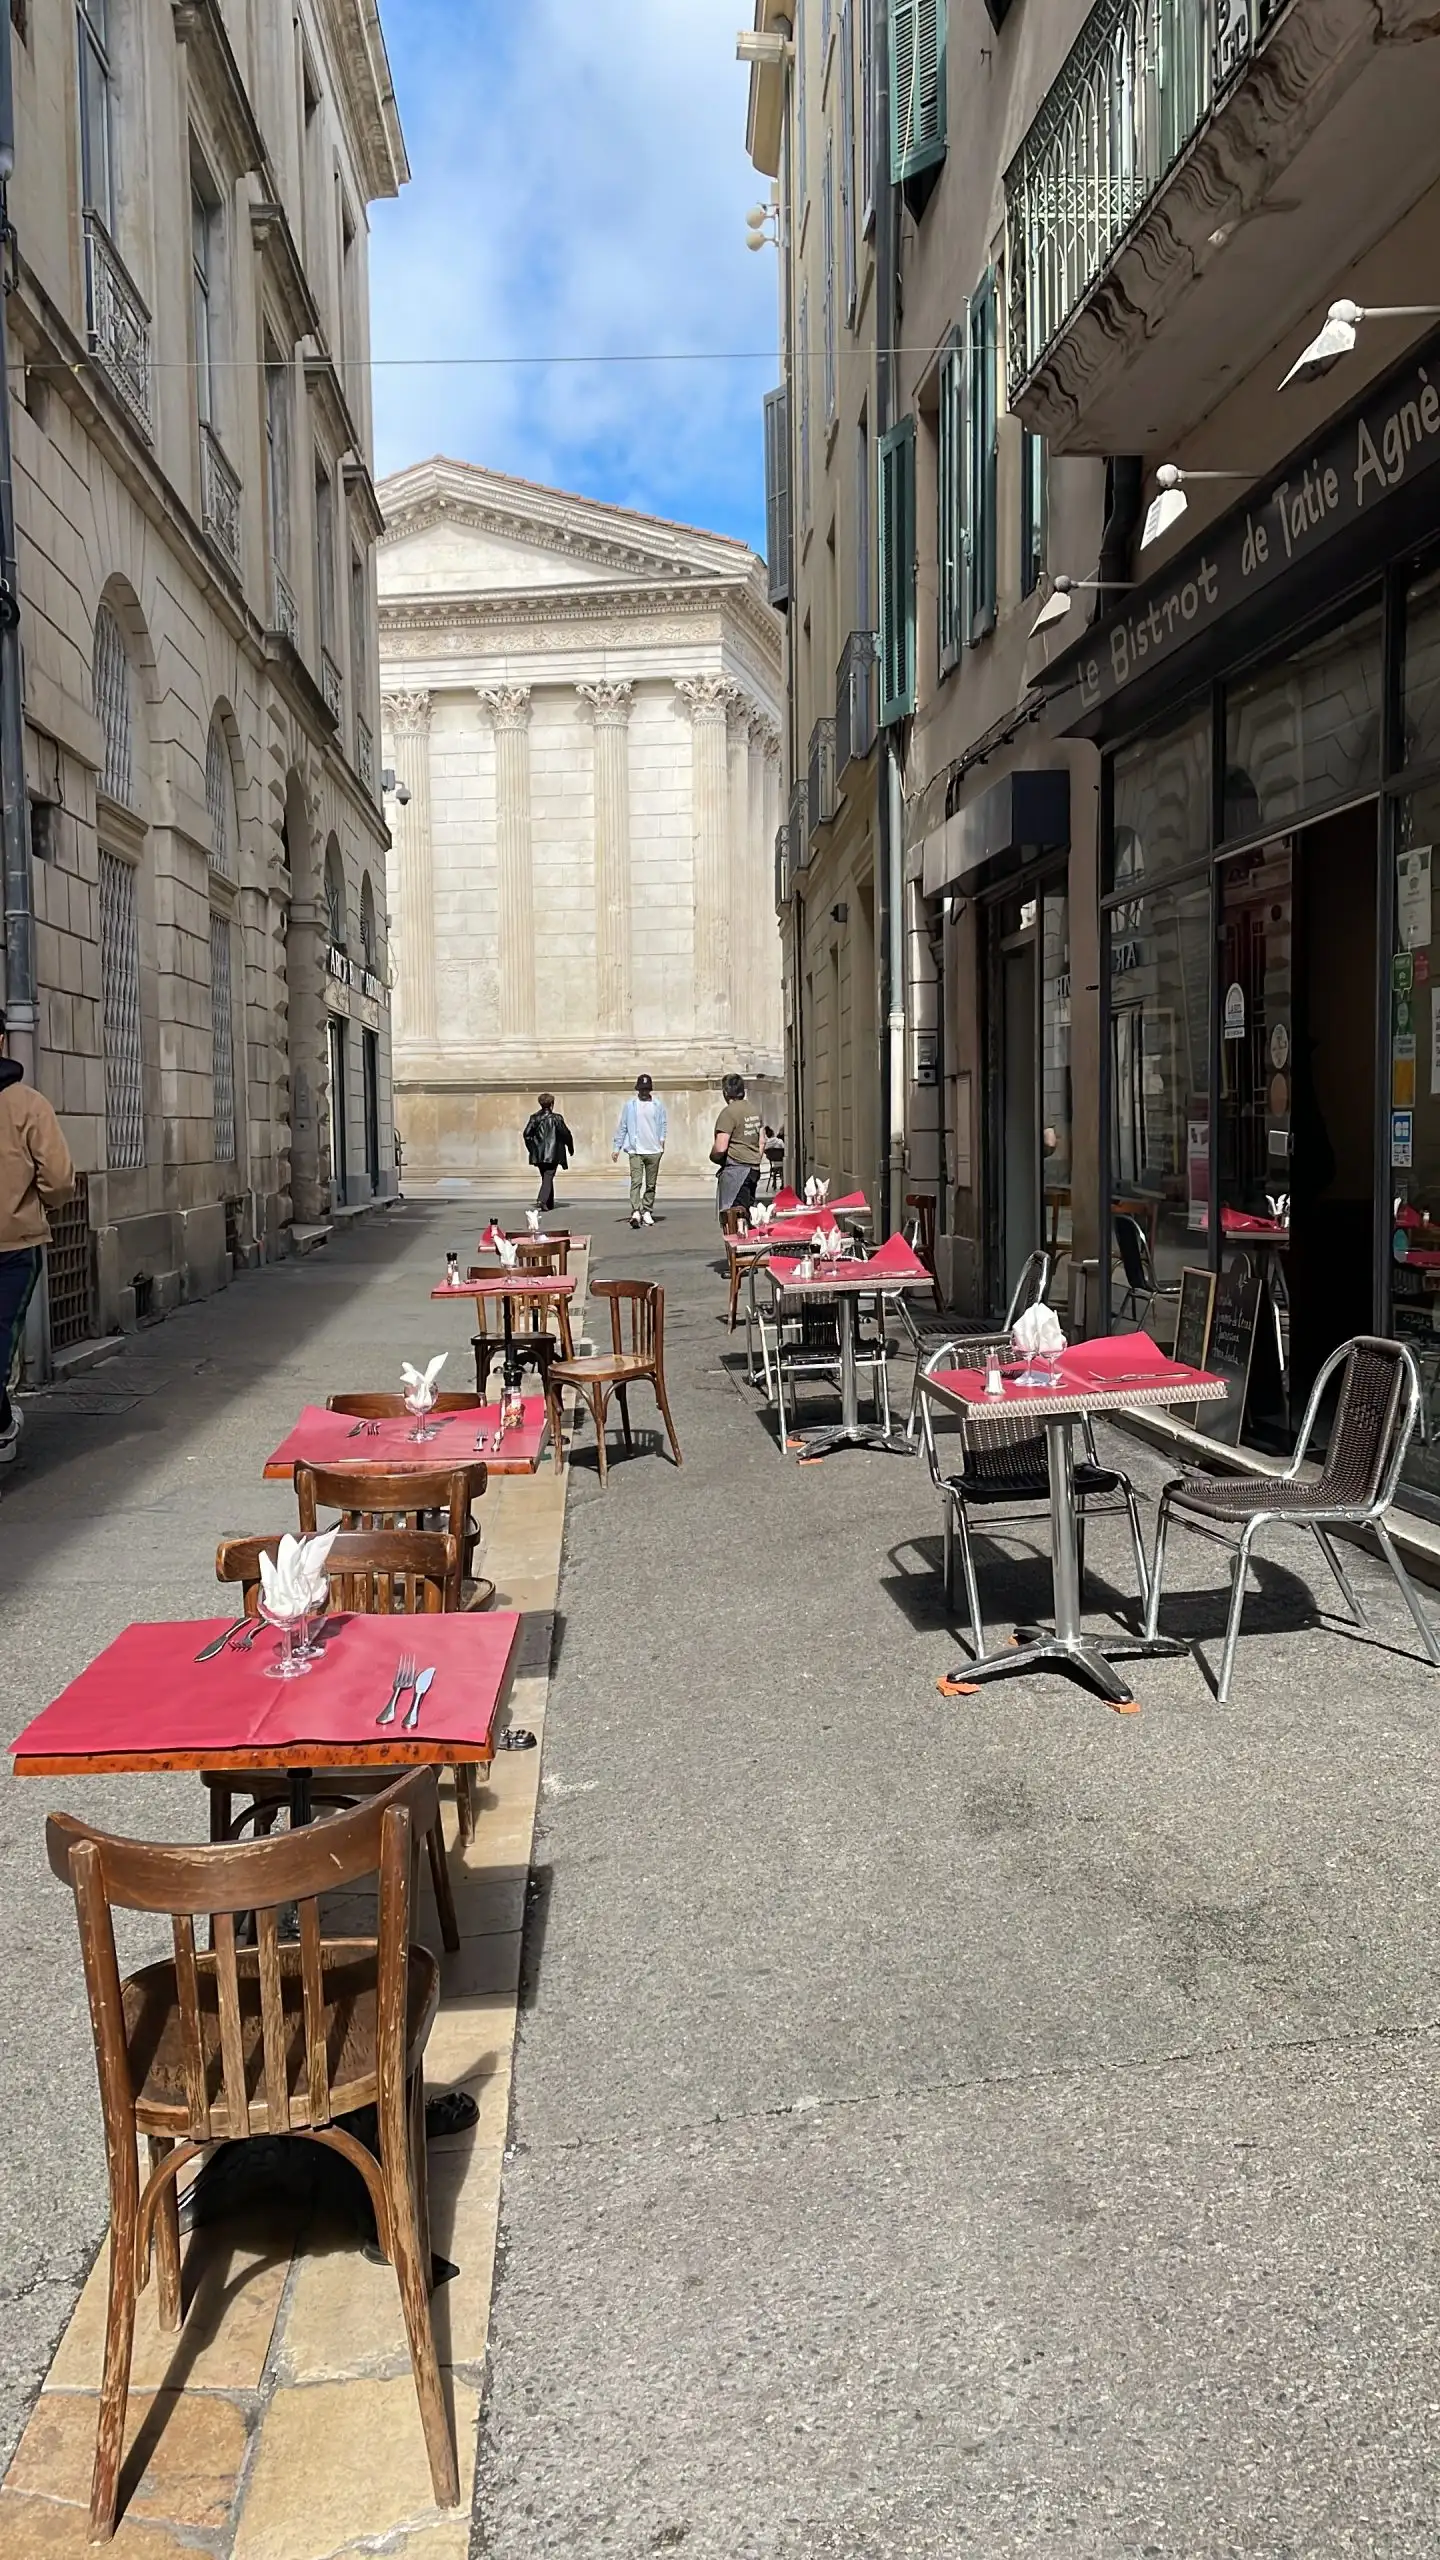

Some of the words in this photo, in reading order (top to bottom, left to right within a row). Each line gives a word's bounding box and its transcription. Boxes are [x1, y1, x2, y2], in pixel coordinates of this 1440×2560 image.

[1077, 659, 1101, 708] Le
[1110, 556, 1218, 685] Bistrot
[1241, 512, 1269, 576] de
[1271, 458, 1339, 558] Tatie
[1353, 366, 1440, 506] Agnè
